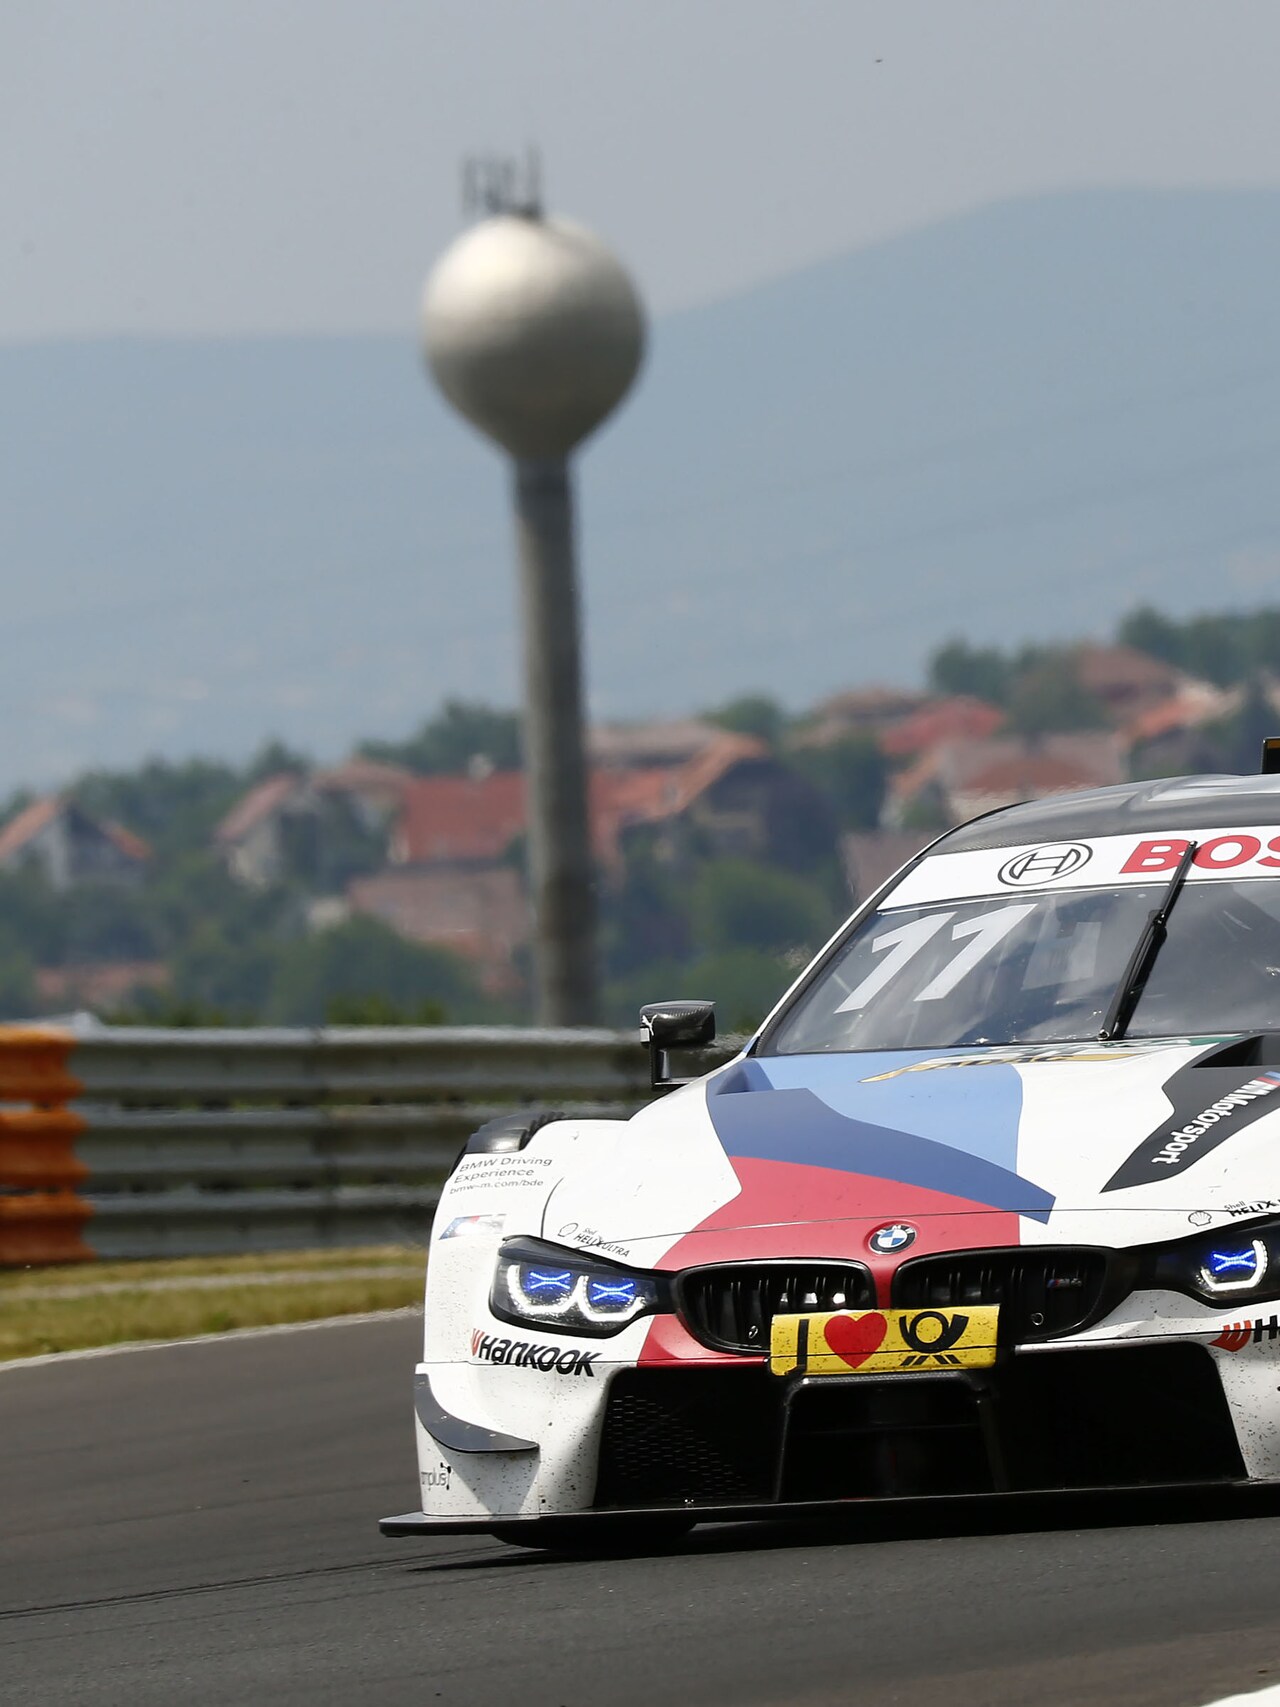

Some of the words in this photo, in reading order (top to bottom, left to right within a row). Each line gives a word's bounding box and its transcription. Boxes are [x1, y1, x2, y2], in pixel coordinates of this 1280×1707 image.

[833, 903, 1038, 1014] 11
[1151, 1093, 1257, 1165] Motorsport
[459, 1157, 498, 1173] BMW
[500, 1156, 553, 1167] Driving
[453, 1169, 535, 1184] Experience
[449, 1179, 544, 1195] bmw-m.com/bde
[601, 1243, 630, 1258] ULTRA
